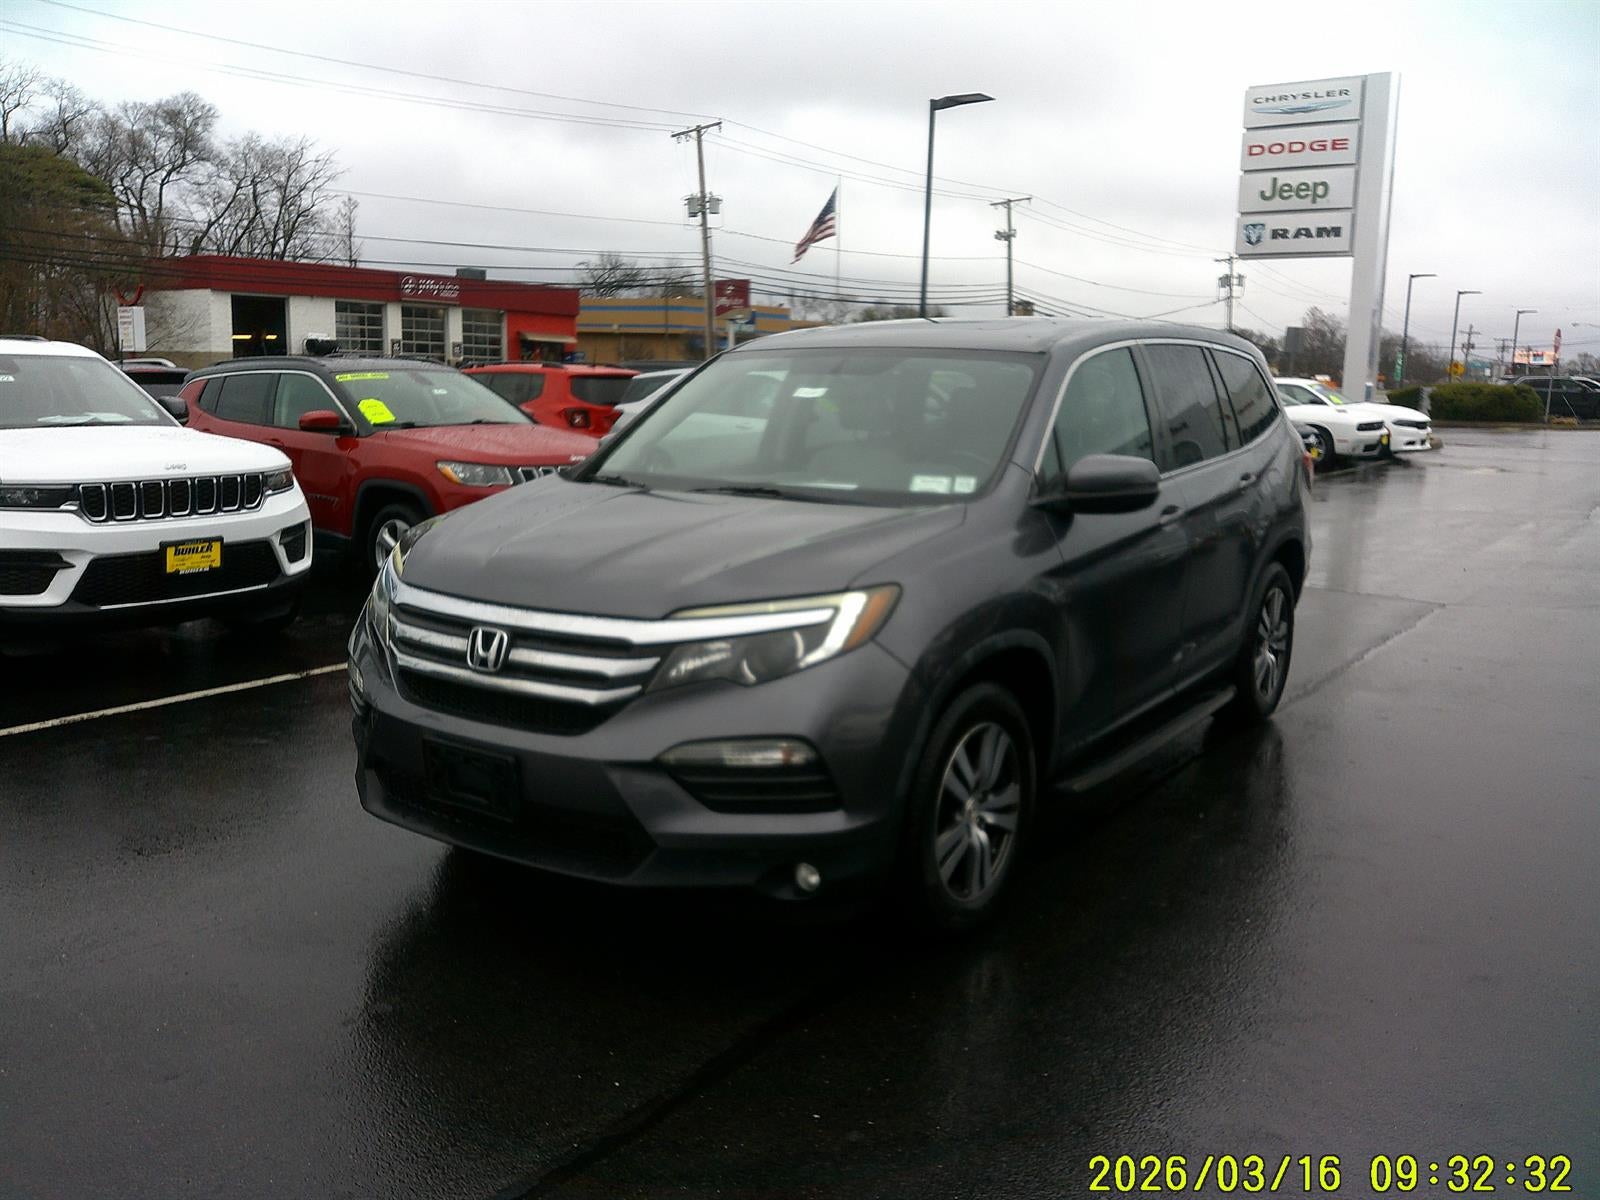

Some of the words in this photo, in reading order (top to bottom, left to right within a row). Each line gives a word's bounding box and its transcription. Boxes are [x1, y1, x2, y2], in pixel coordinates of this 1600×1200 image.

[1253, 88, 1351, 104] CHRYSLER
[1248, 138, 1349, 156] DODGE
[1260, 177, 1330, 204] Jeep
[1271, 226, 1342, 240] RAM
